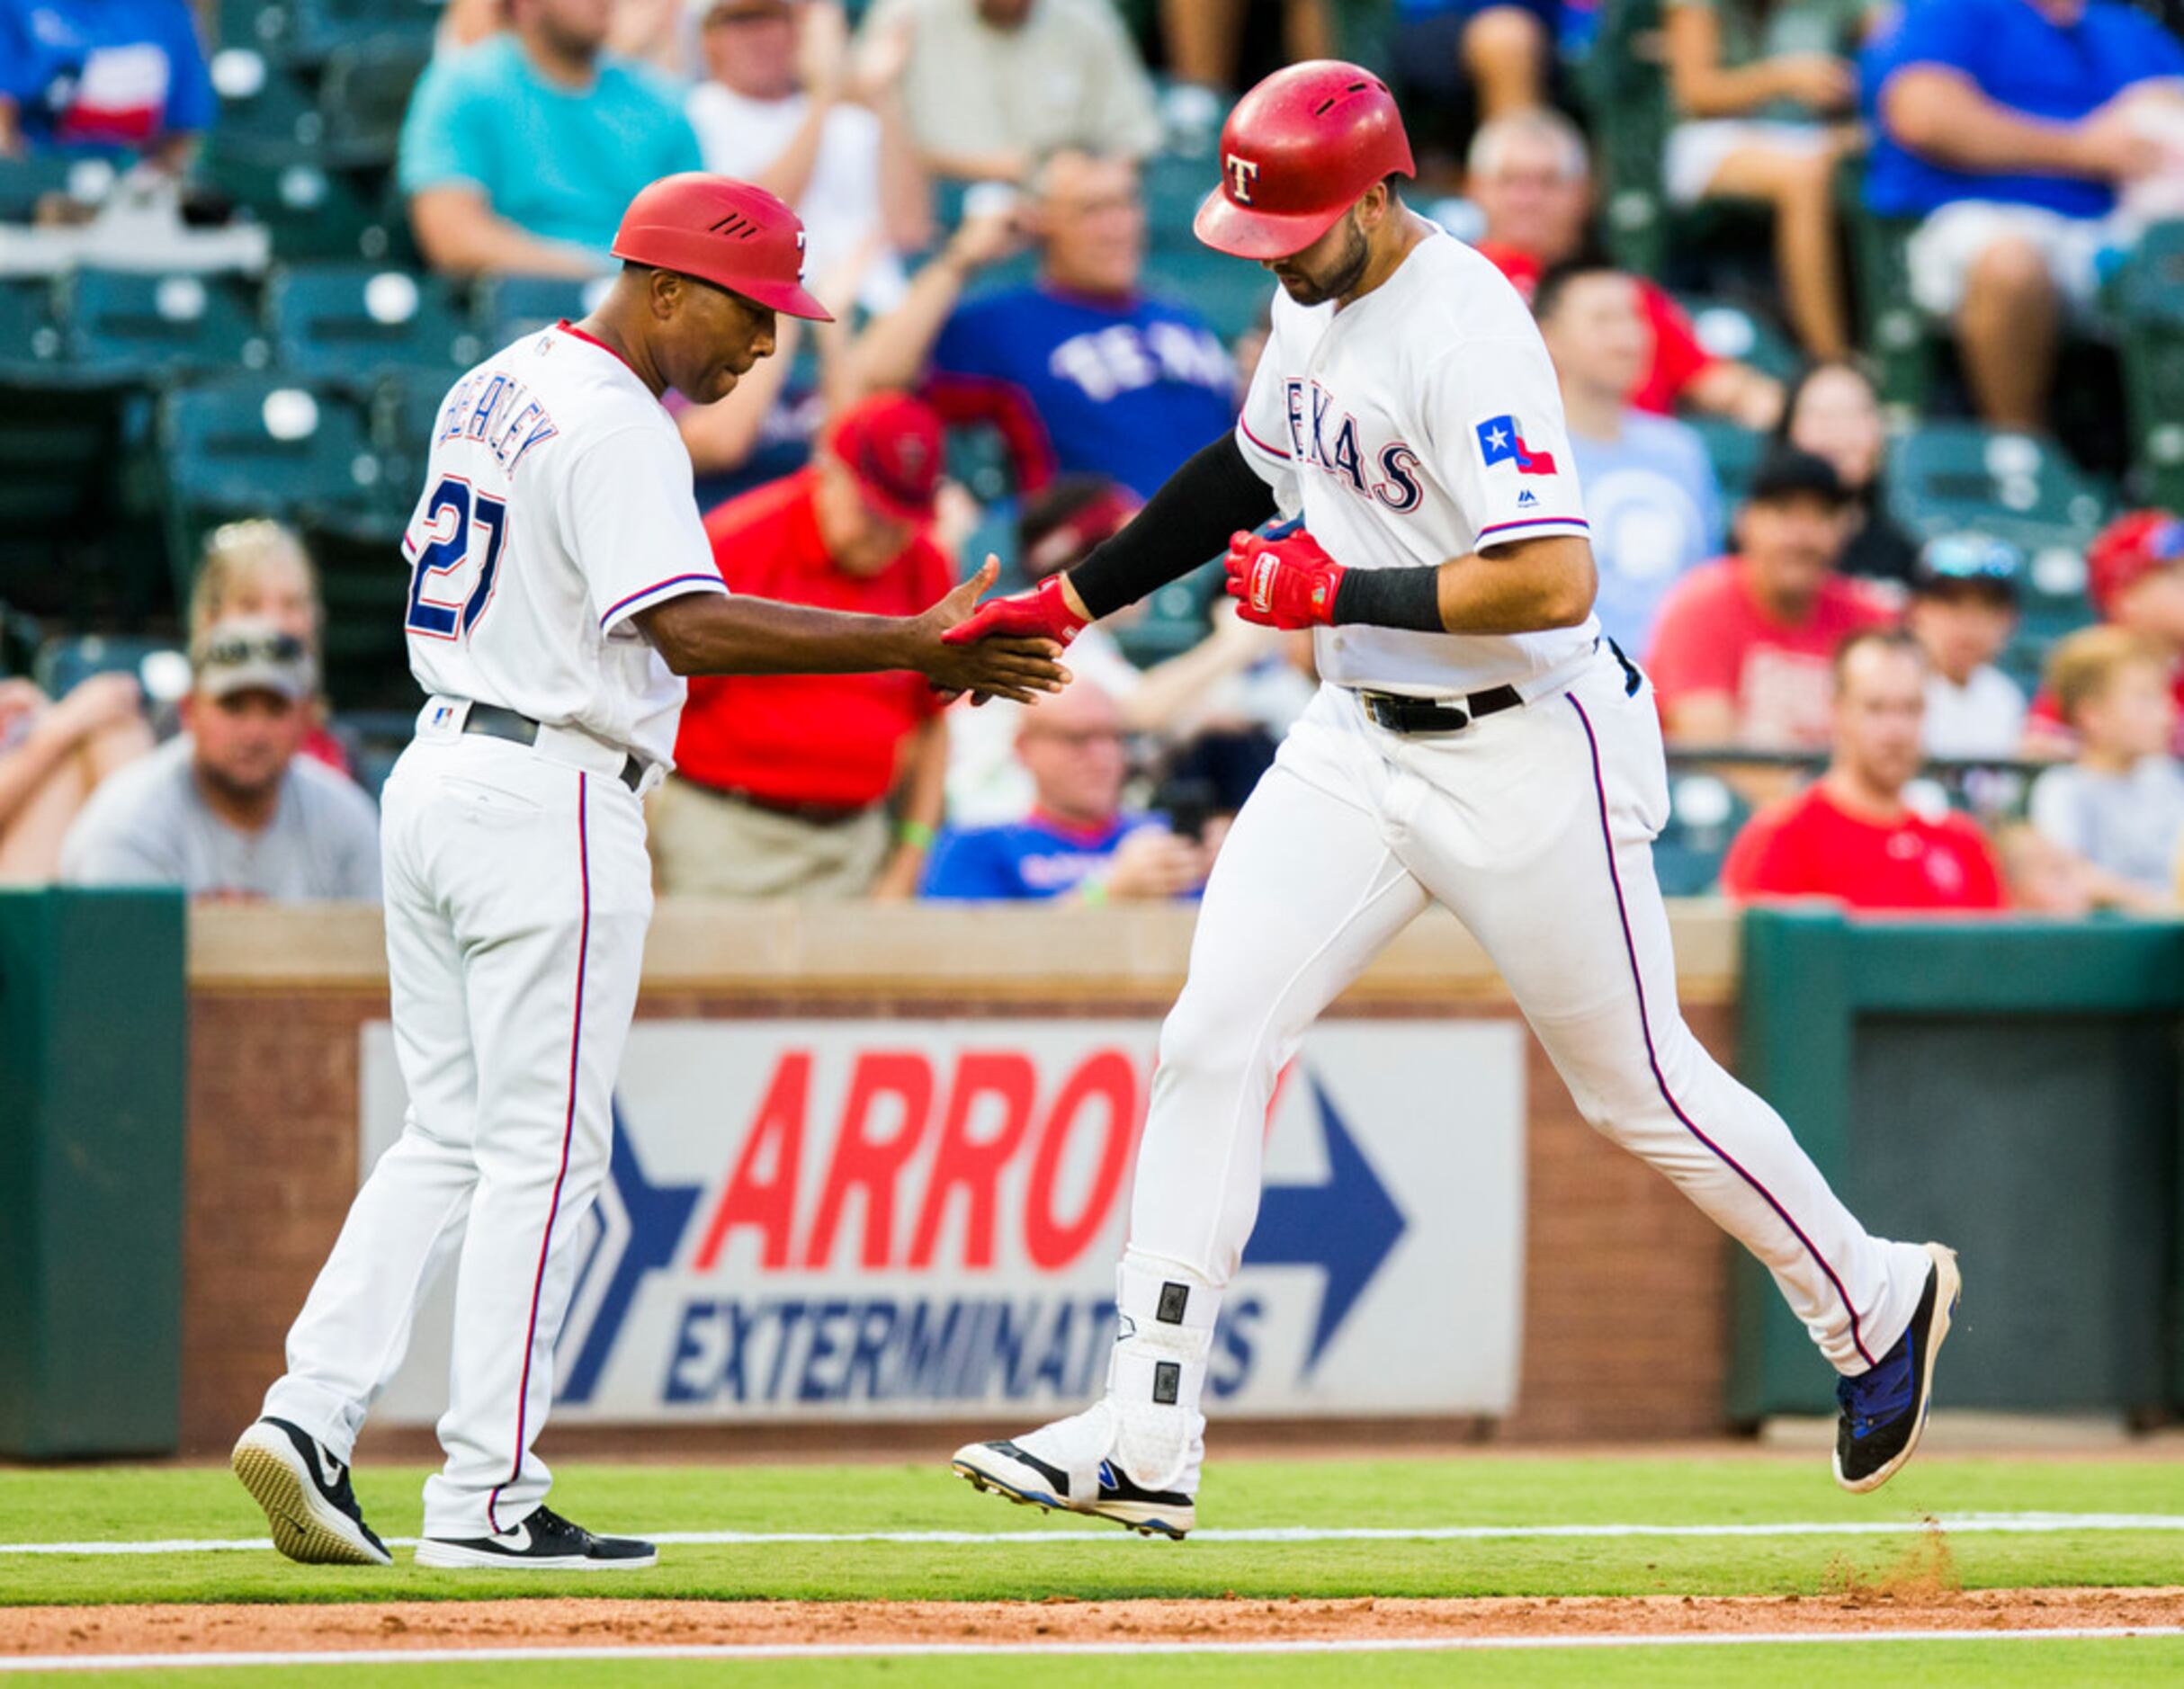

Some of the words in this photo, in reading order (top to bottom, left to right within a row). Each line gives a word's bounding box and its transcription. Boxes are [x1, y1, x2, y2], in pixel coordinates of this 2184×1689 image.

[1227, 153, 1260, 205] T
[1281, 376, 1424, 515] EXAS
[405, 472, 510, 652] 27
[693, 1049, 1296, 1272] ARRO
[661, 1295, 1264, 1405] EXTERMINATS
